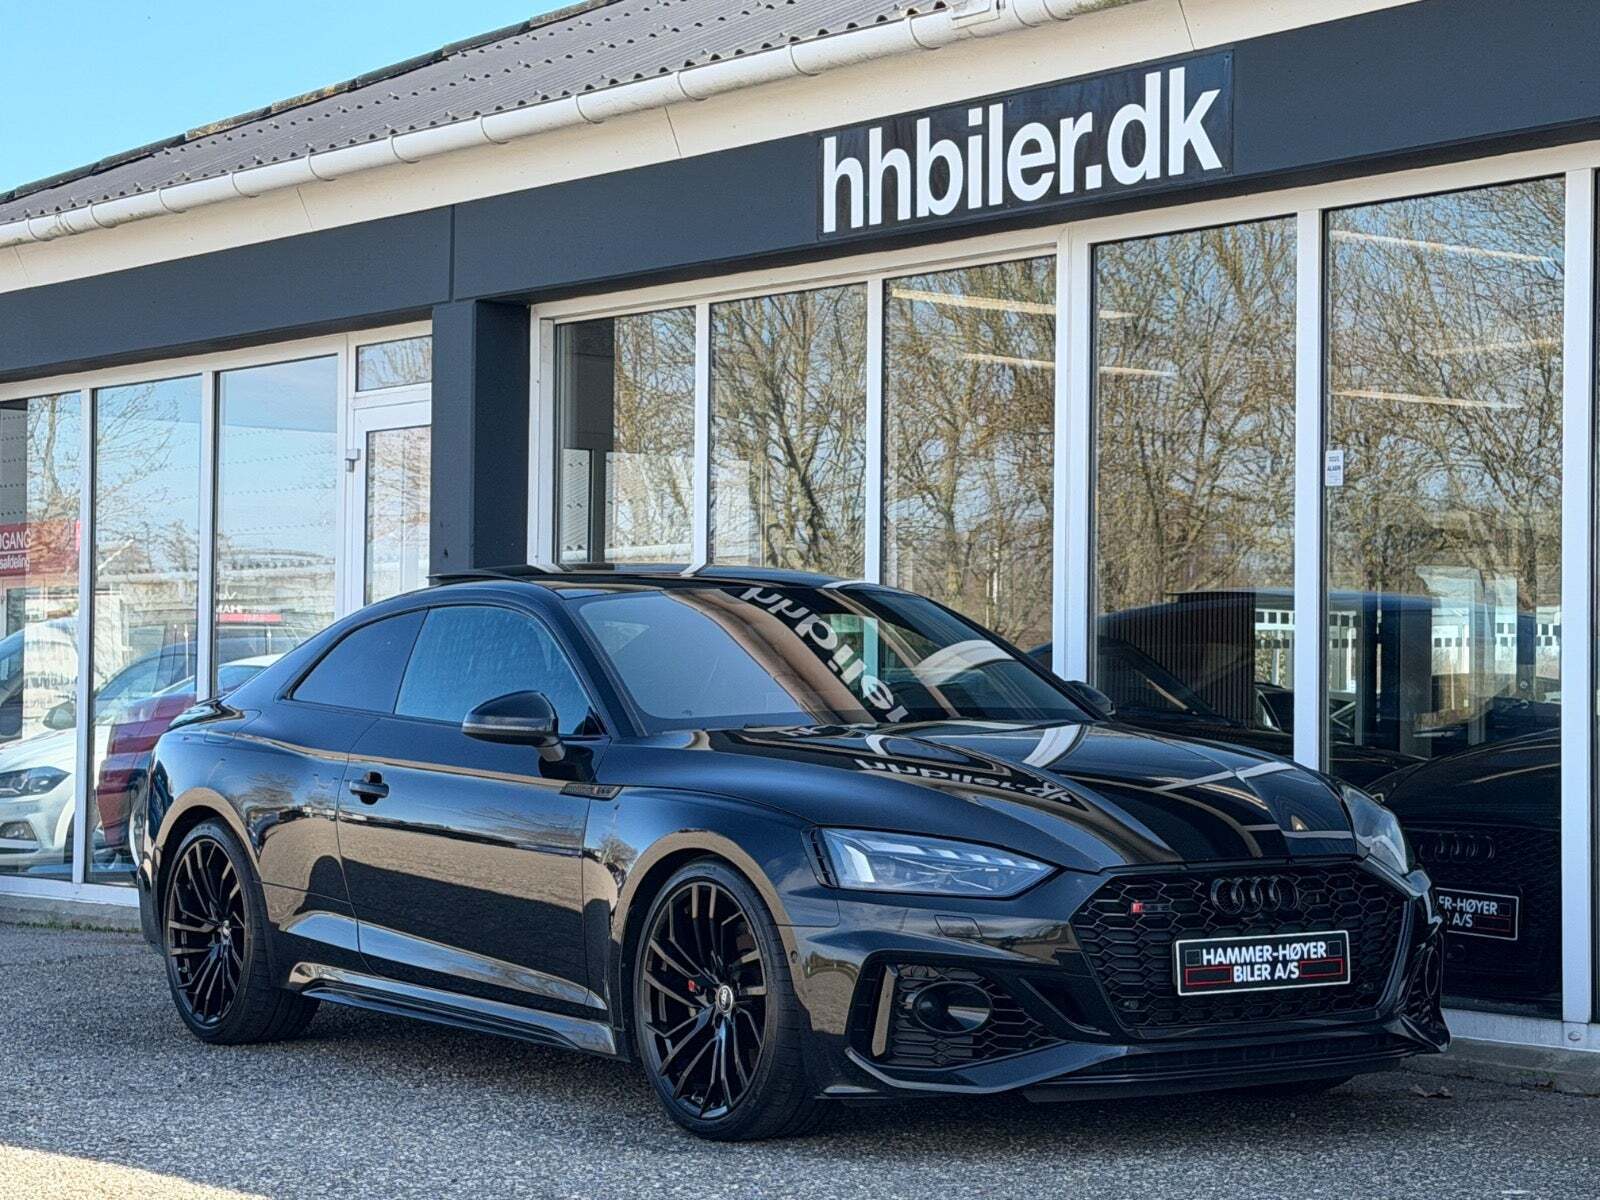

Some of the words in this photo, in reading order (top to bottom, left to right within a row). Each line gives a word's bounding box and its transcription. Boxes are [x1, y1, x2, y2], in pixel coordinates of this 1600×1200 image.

[822, 66, 1223, 234] hhbiler.dk
[0, 529, 31, 549] GANG
[1452, 912, 1473, 928] A/S
[1202, 941, 1327, 966] HAMMER-HØYER
[1233, 965, 1272, 983] BILER
[1274, 962, 1300, 980] A/S
